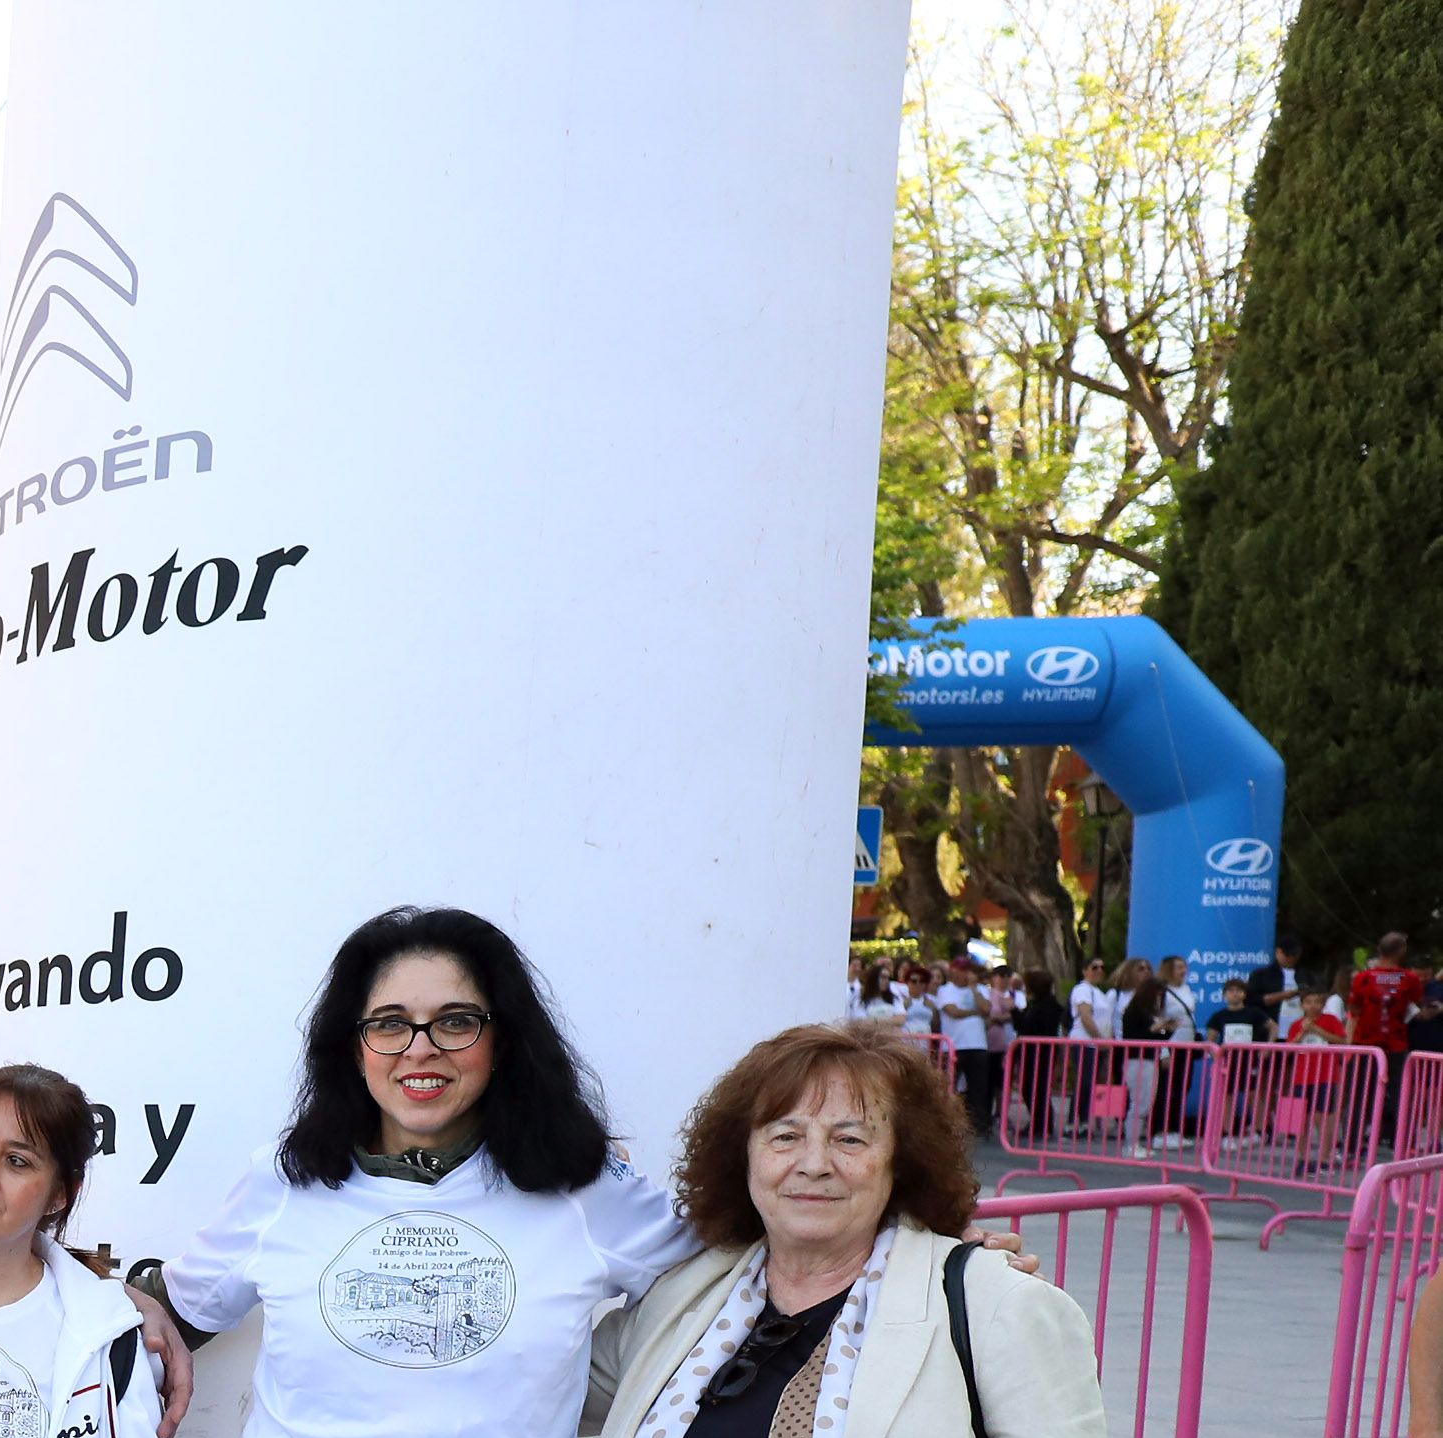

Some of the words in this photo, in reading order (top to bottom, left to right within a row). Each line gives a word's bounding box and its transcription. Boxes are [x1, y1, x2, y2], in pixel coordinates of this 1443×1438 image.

[139, 1103, 197, 1185] y
[385, 1227, 390, 1235] I
[395, 1227, 458, 1236] MEMORIAL
[381, 1235, 459, 1247] CIPRIANO
[382, 1248, 411, 1257] Amigo
[425, 1249, 437, 1257] los
[403, 1262, 428, 1270] Abril
[432, 1262, 453, 1270] 2024
